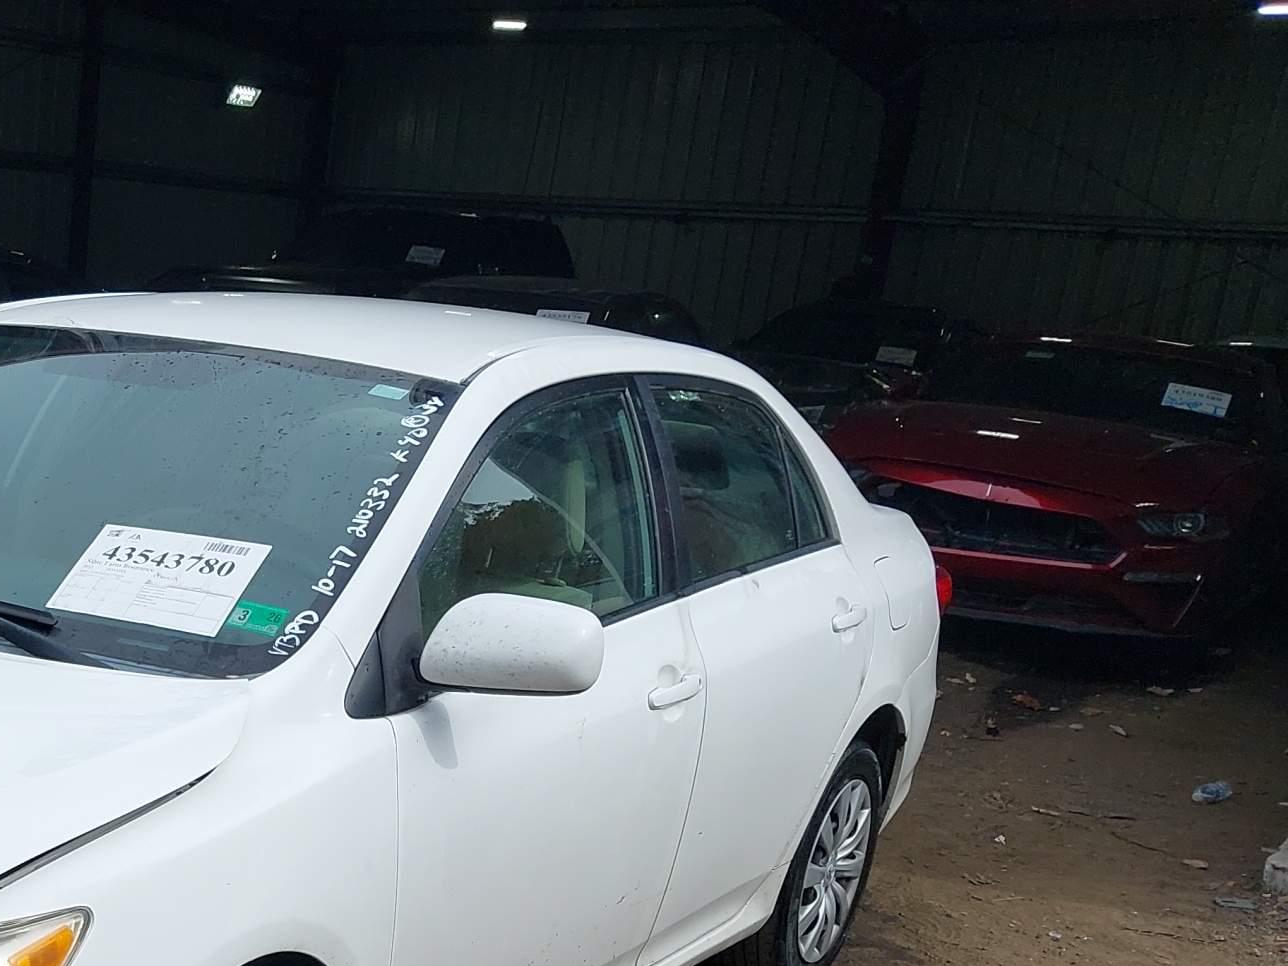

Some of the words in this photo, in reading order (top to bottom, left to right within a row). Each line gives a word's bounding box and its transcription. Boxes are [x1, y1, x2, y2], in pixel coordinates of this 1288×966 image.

[102, 545, 235, 577] 43543780
[312, 545, 357, 596] 10-17
[238, 609, 250, 621] 3
